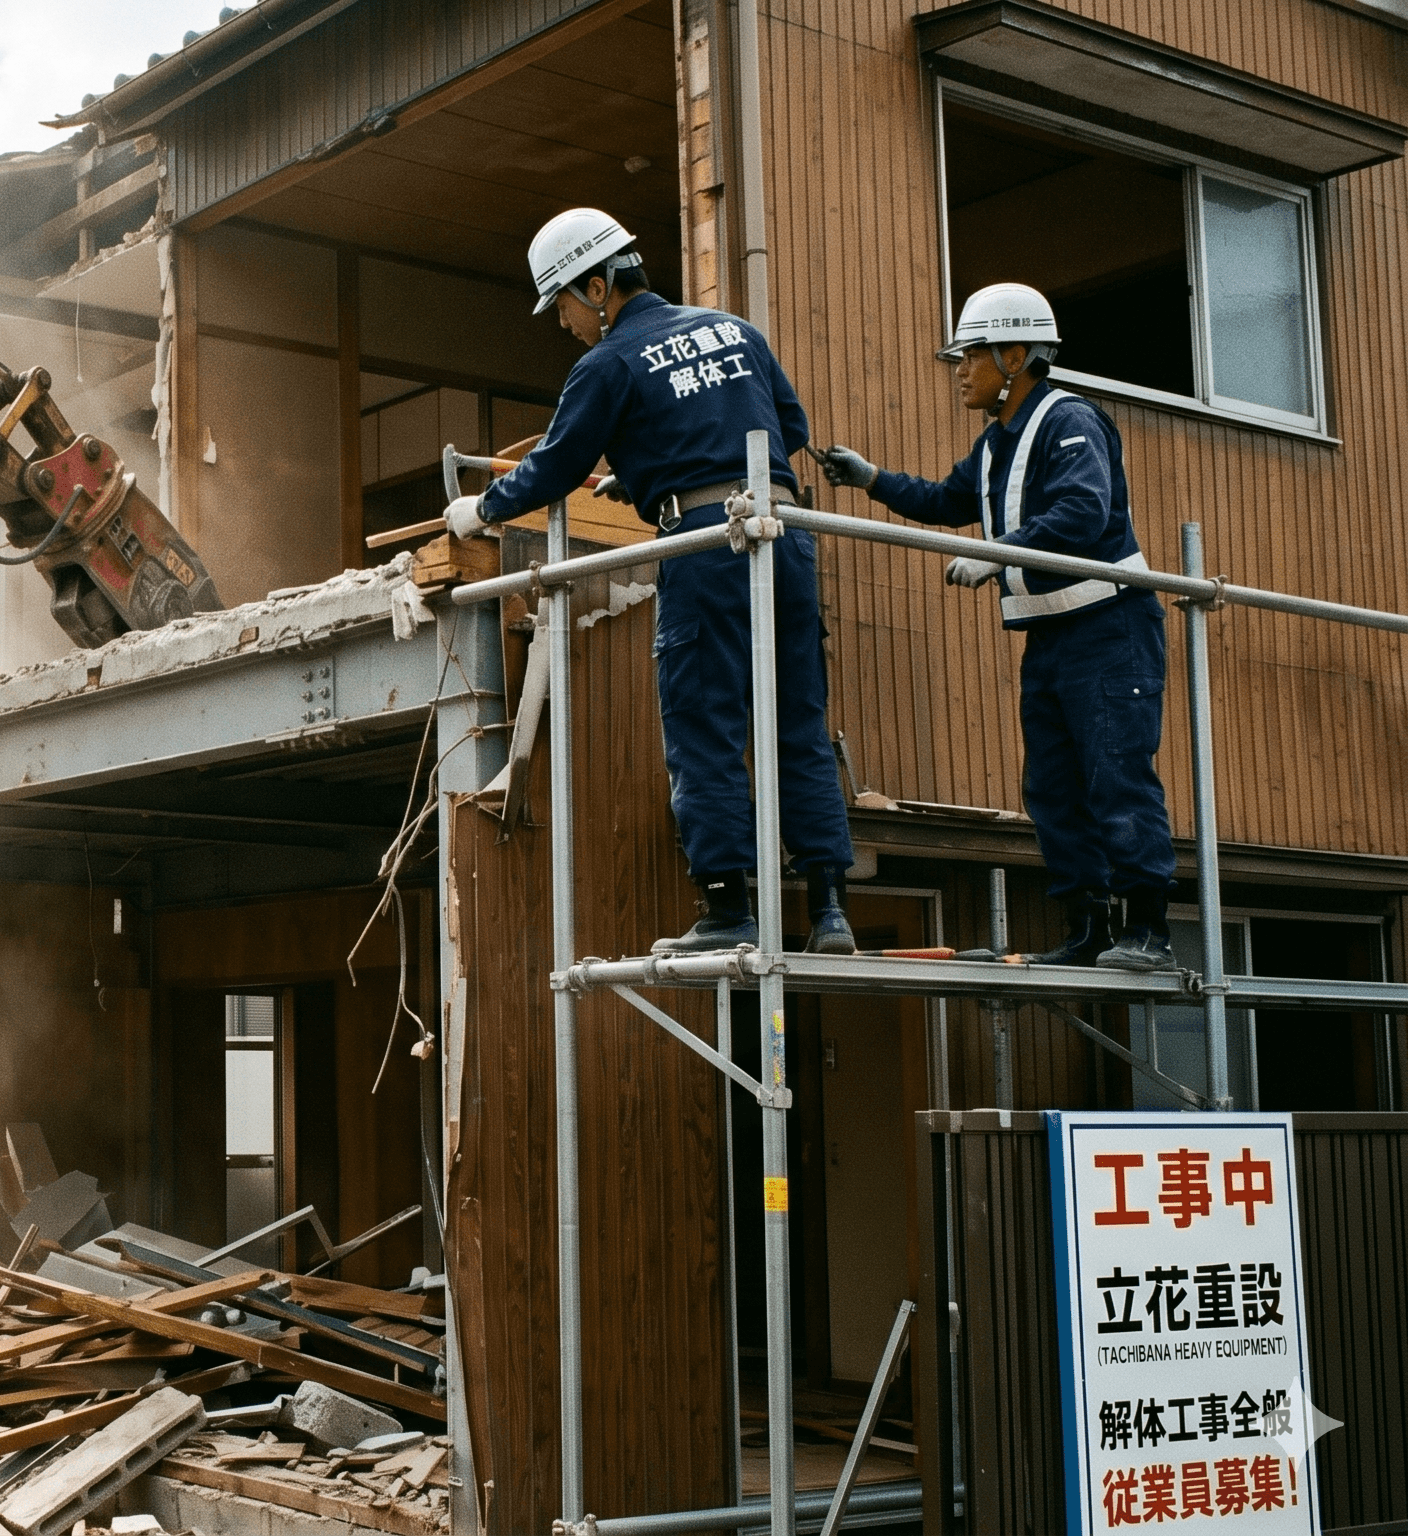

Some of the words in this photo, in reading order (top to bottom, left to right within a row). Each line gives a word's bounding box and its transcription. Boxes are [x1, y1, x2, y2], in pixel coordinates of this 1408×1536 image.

[640, 321, 748, 373] 立花重設
[668, 353, 753, 399] 解体工
[1094, 1148, 1274, 1229] 工事中
[1096, 1262, 1284, 1334] 立花重設
[1097, 1343, 1171, 1366] (TACHIBANA
[1174, 1341, 1212, 1360] HEAVY
[1216, 1335, 1288, 1358] EQUIPMENT)
[1098, 1388, 1294, 1451] 解体工事全般
[1102, 1454, 1298, 1528] 従業員募集!
